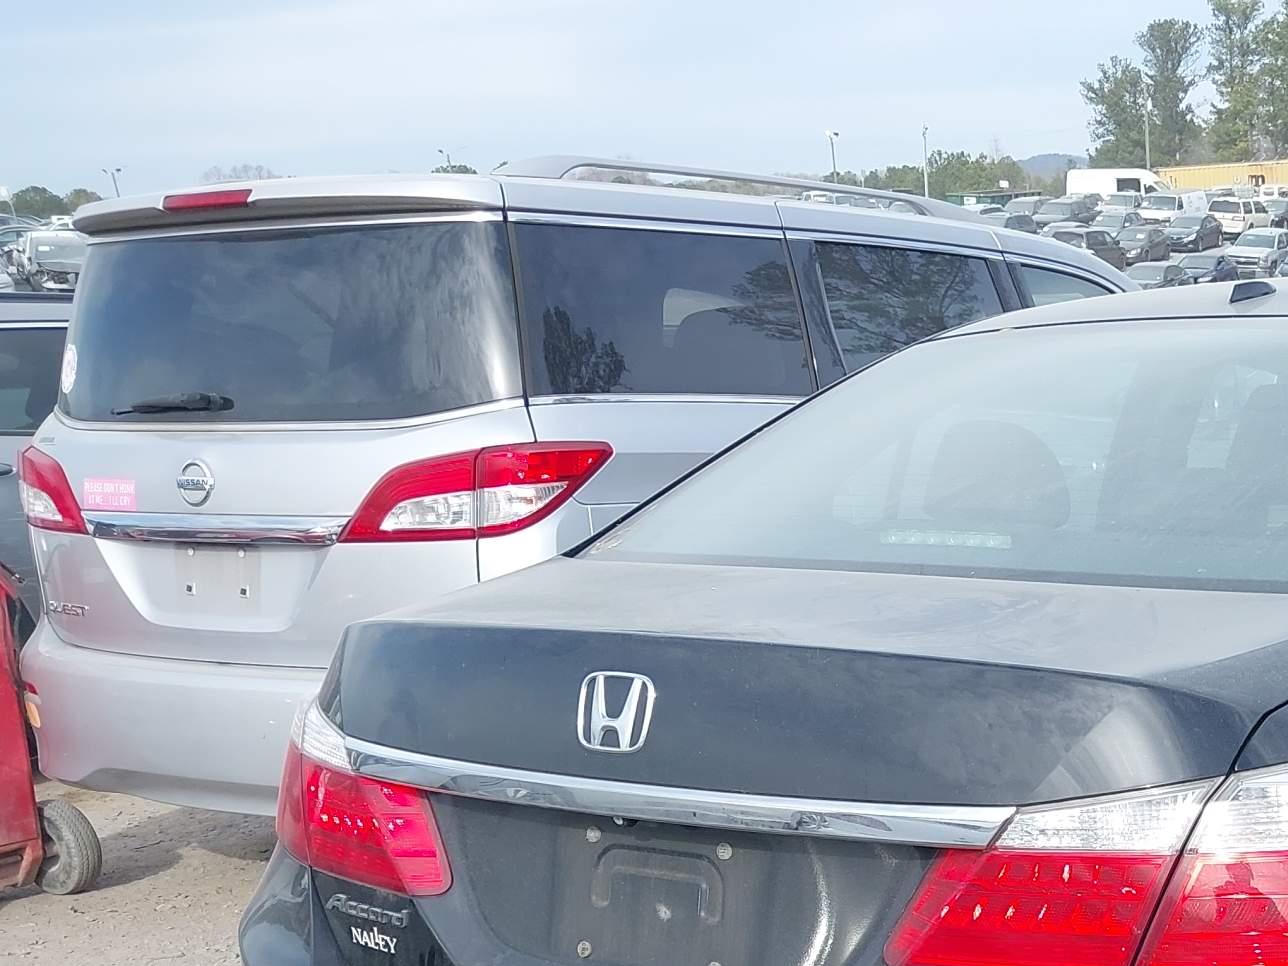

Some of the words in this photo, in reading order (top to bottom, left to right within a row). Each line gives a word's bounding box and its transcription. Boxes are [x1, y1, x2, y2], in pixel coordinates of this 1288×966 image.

[177, 478, 209, 487] NISSAN
[49, 600, 88, 617] QUEST
[325, 892, 411, 928] Accord
[350, 926, 398, 955] NALLEY
